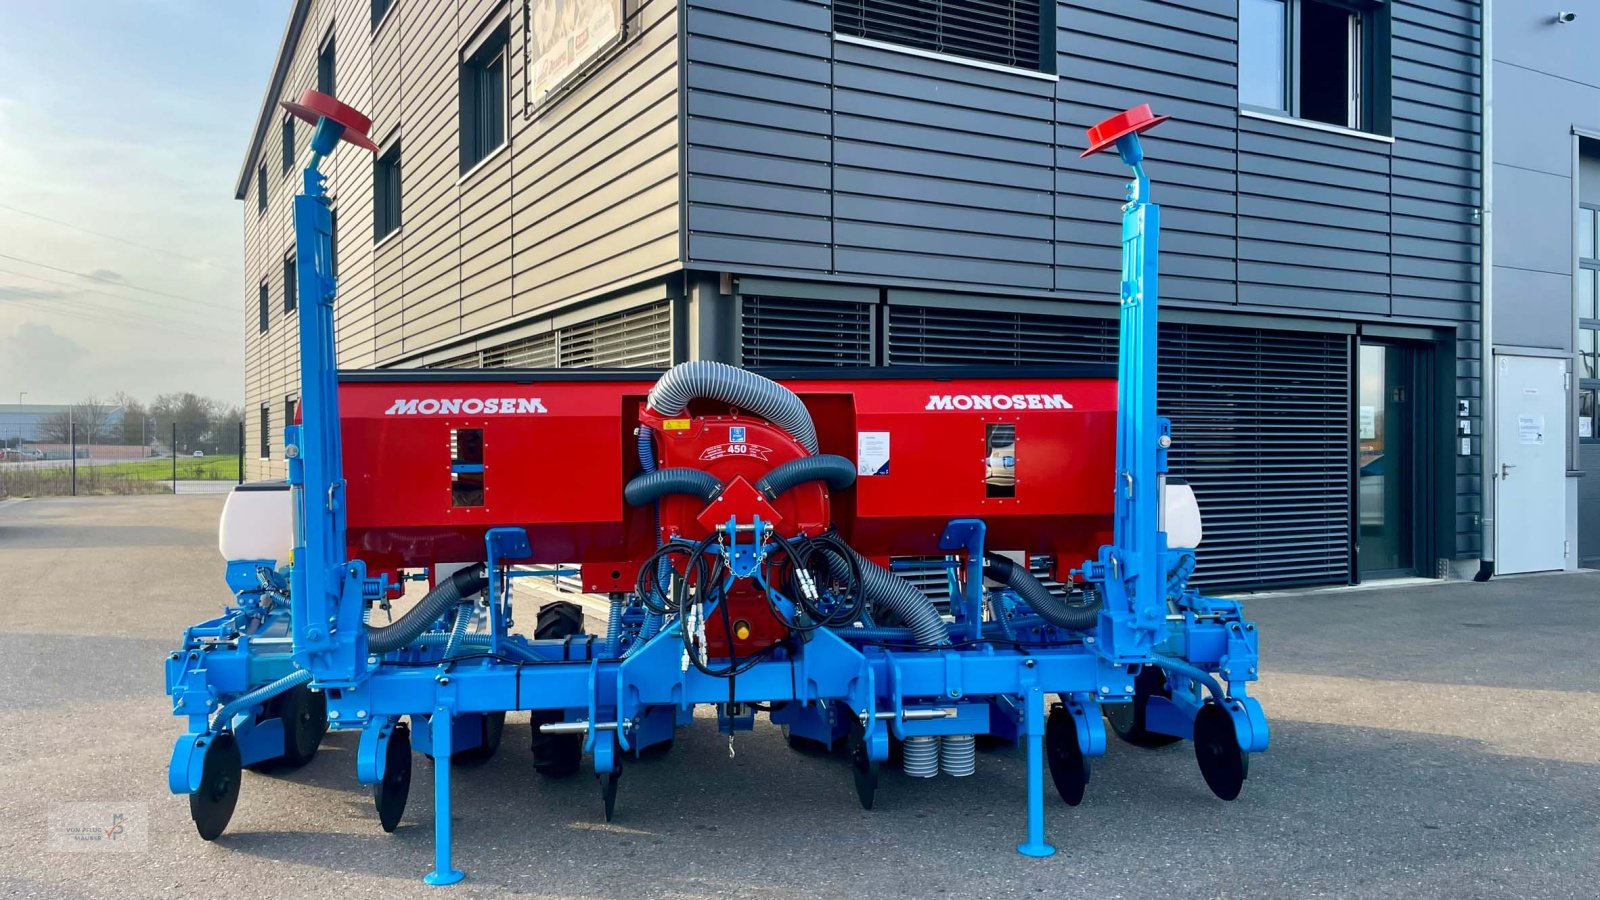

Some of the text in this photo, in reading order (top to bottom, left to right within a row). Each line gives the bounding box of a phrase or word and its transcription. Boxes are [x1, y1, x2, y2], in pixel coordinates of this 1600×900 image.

[384, 398, 548, 415] MONOSEM
[925, 394, 1073, 410] MONOSEM
[727, 444, 747, 454] 450
